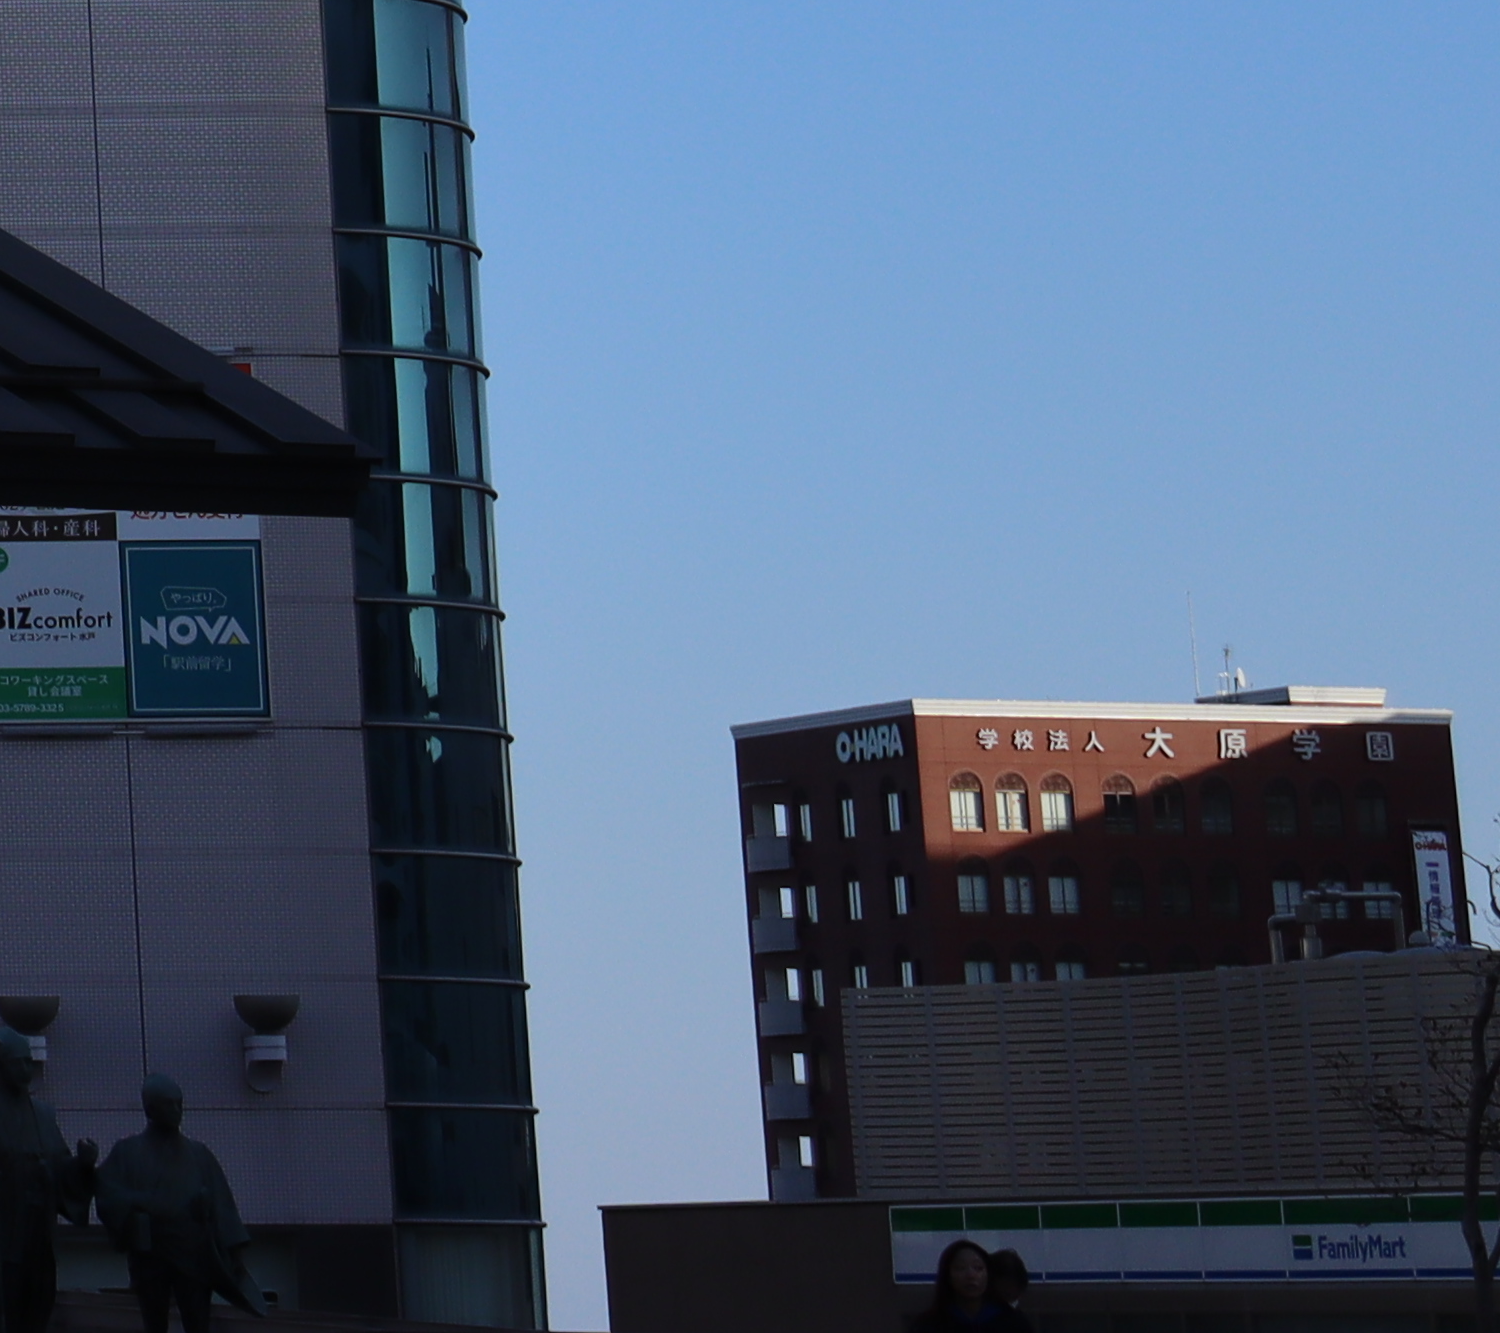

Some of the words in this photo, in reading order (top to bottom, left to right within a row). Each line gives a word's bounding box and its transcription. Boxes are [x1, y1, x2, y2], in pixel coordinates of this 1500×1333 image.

[16, 588, 50, 603] SHARED
[53, 587, 85, 602] OFFICE
[140, 615, 250, 649] NOVA
[0, 674, 109, 686] コワーキングスペース
[978, 728, 1105, 751] 学校法人
[1144, 726, 1395, 762] 大原学園
[1318, 1234, 1406, 1262] FamilyMart
